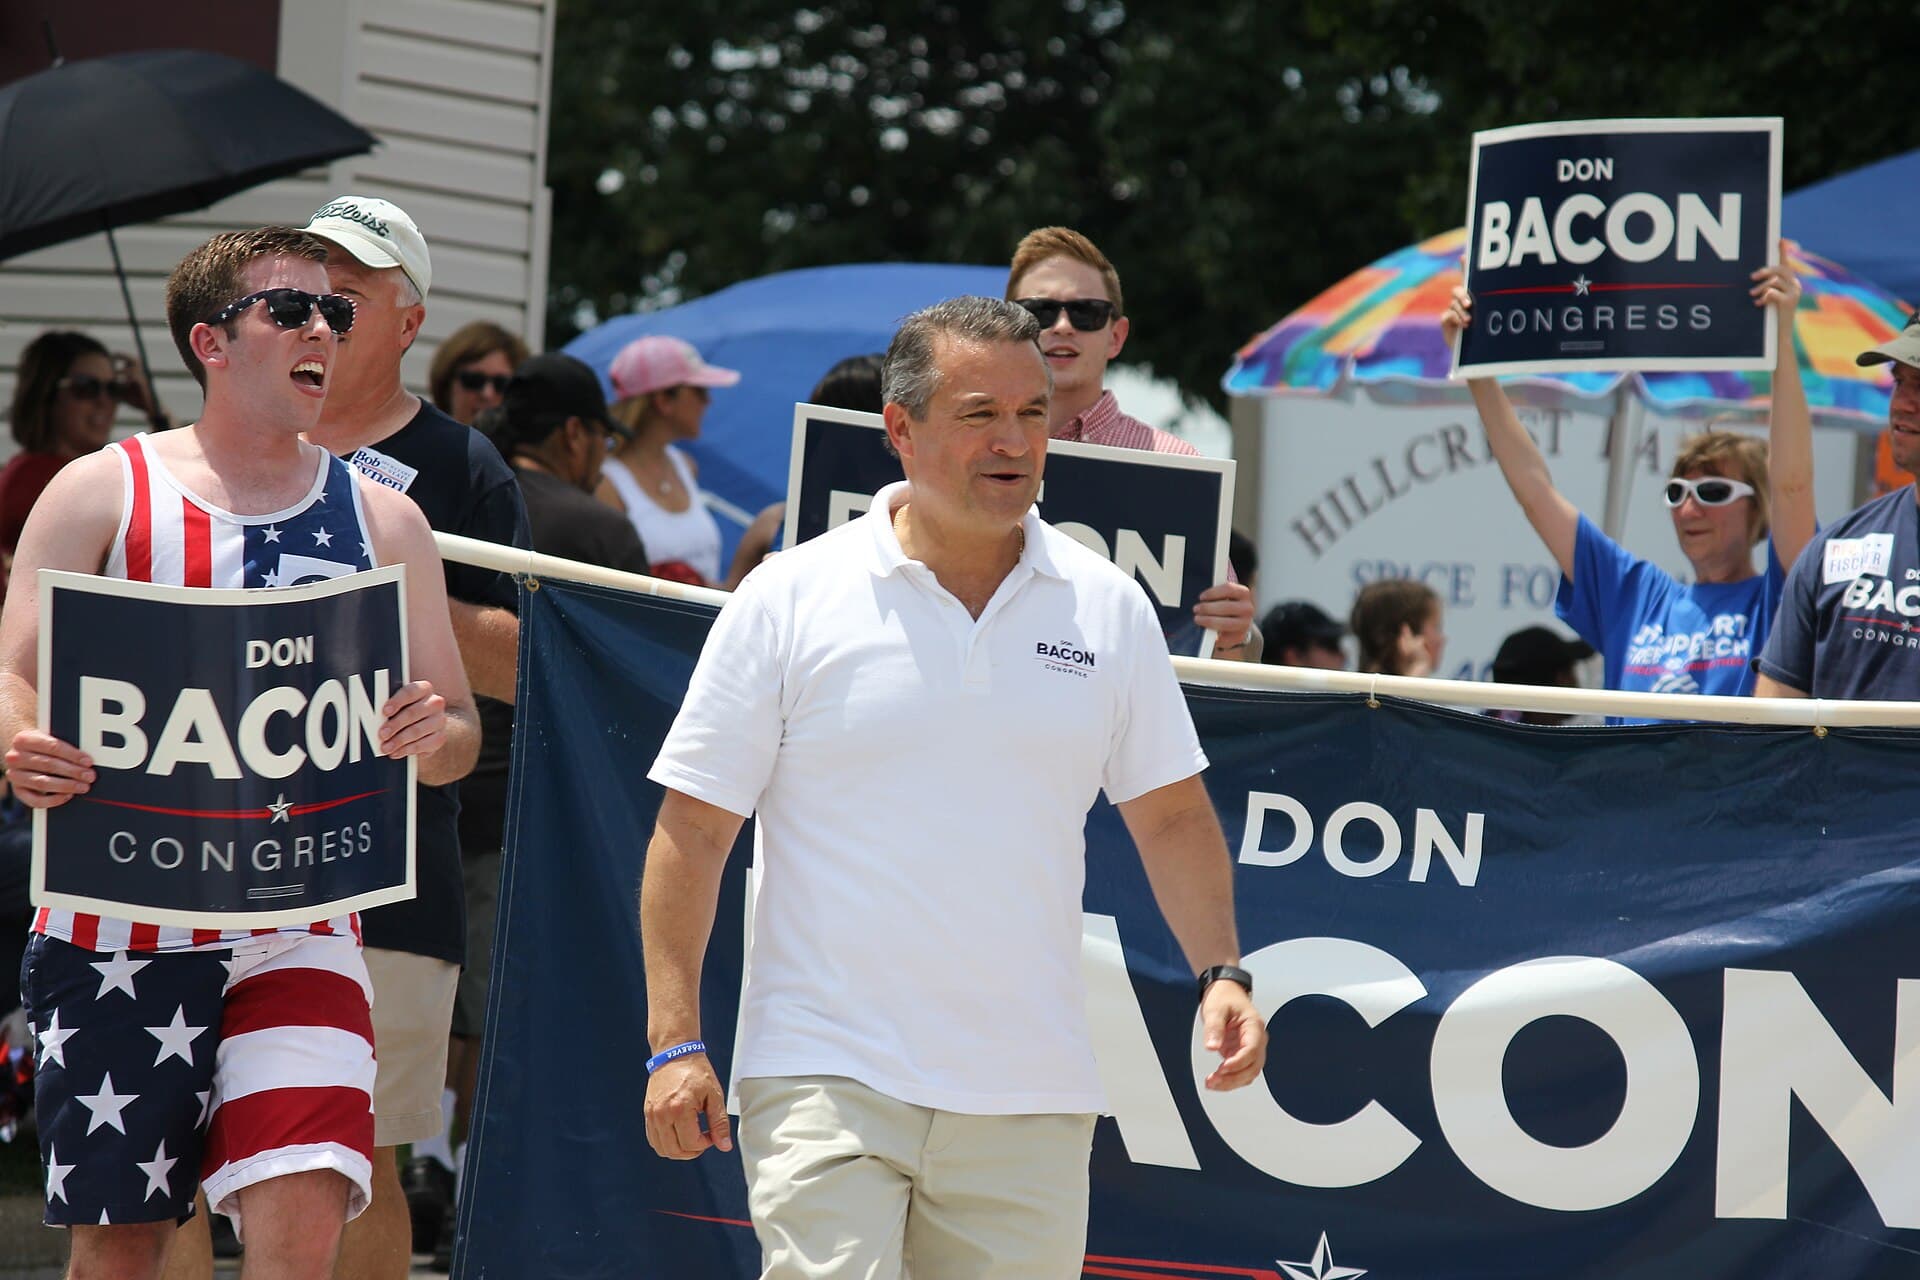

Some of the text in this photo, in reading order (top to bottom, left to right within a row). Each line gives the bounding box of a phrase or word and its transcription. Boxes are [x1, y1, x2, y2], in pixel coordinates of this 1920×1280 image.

[1557, 158, 1614, 183] DON
[1477, 191, 1742, 271] BACON
[1488, 304, 1712, 336] CONGRESS
[356, 450, 381, 467] Bob
[1291, 408, 1573, 559] HILLCRT
[245, 634, 314, 669] DON
[1037, 642, 1095, 667] BACON
[79, 668, 391, 780] BACON
[108, 821, 373, 873] CONGRESS
[1238, 790, 1486, 887] DON
[1082, 912, 1920, 1230] CON
